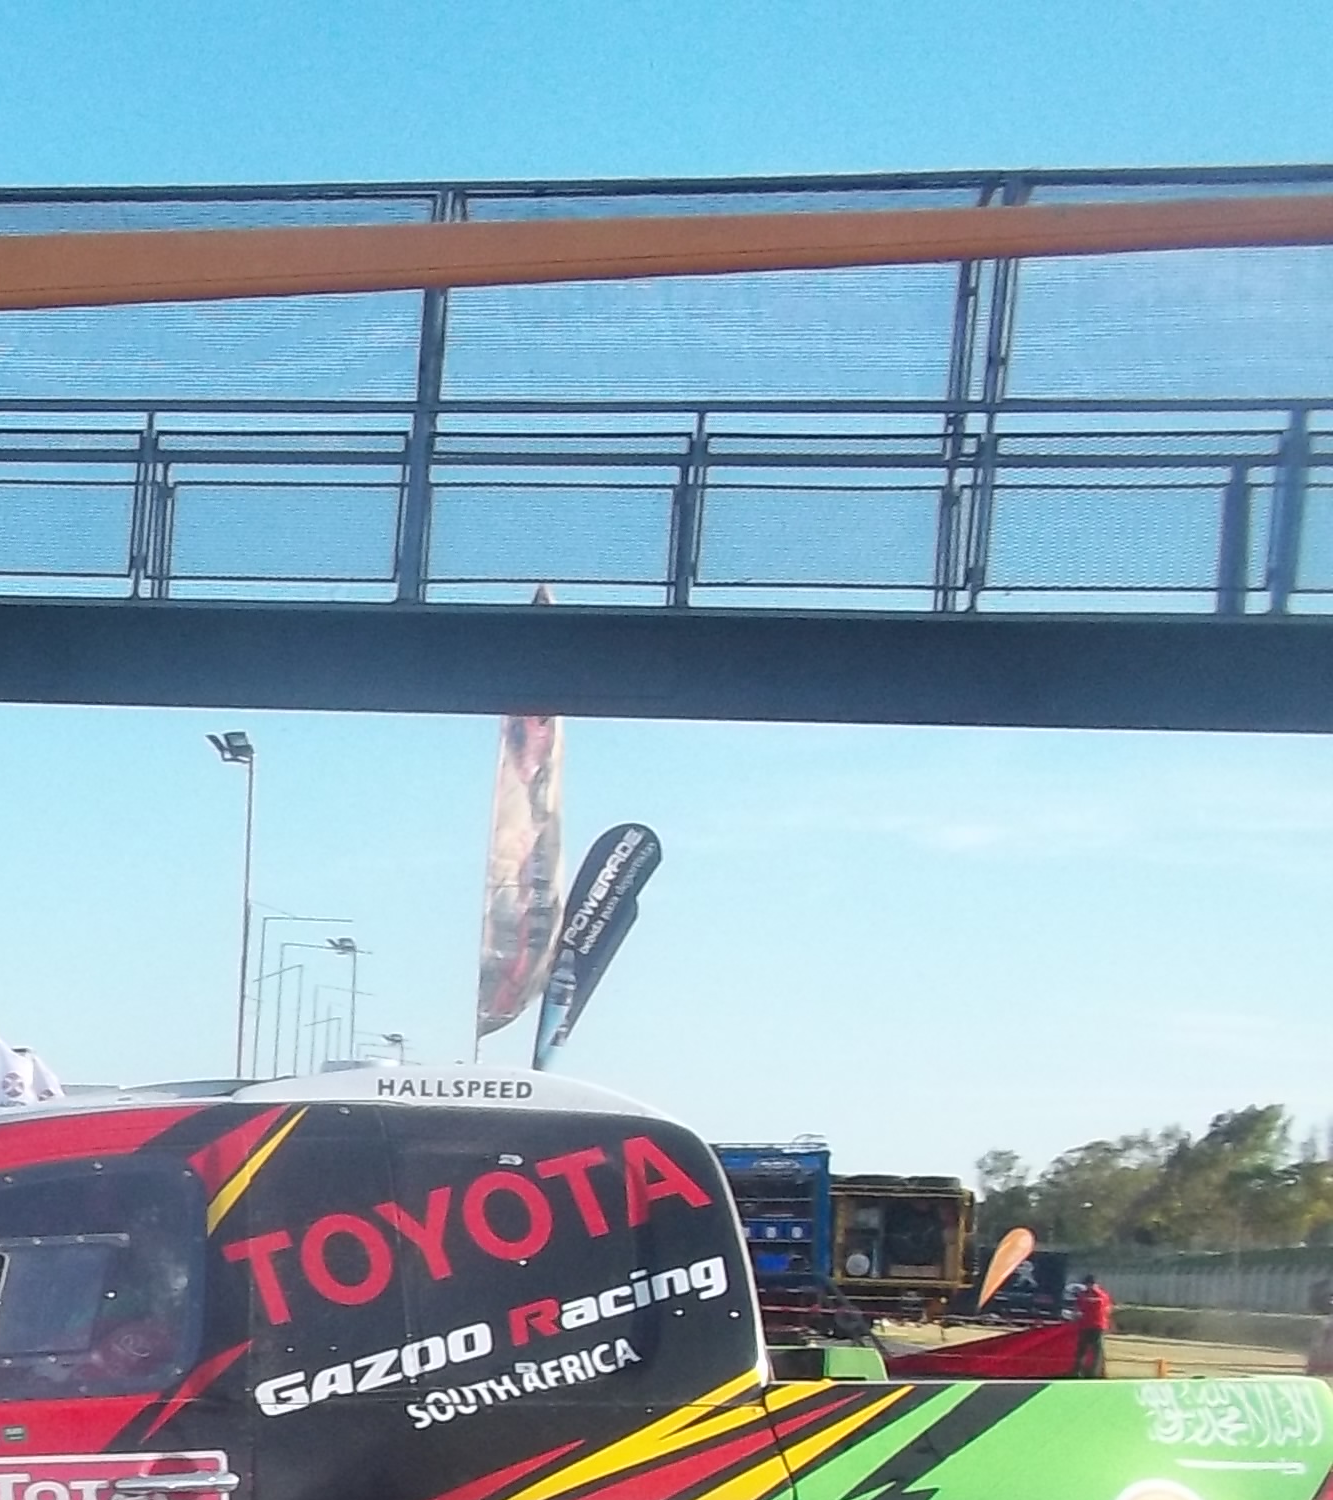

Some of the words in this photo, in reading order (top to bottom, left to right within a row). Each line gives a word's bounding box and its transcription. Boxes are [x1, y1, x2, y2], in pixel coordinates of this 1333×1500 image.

[563, 828, 645, 946] POWERADE
[377, 1077, 533, 1100] HALLSPEED
[223, 1136, 713, 1326] TOYOTA
[254, 1322, 494, 1417] GAZOO
[508, 1255, 728, 1347] Racing
[405, 1372, 521, 1430] SOUTH
[520, 1337, 641, 1394] AFRICA
